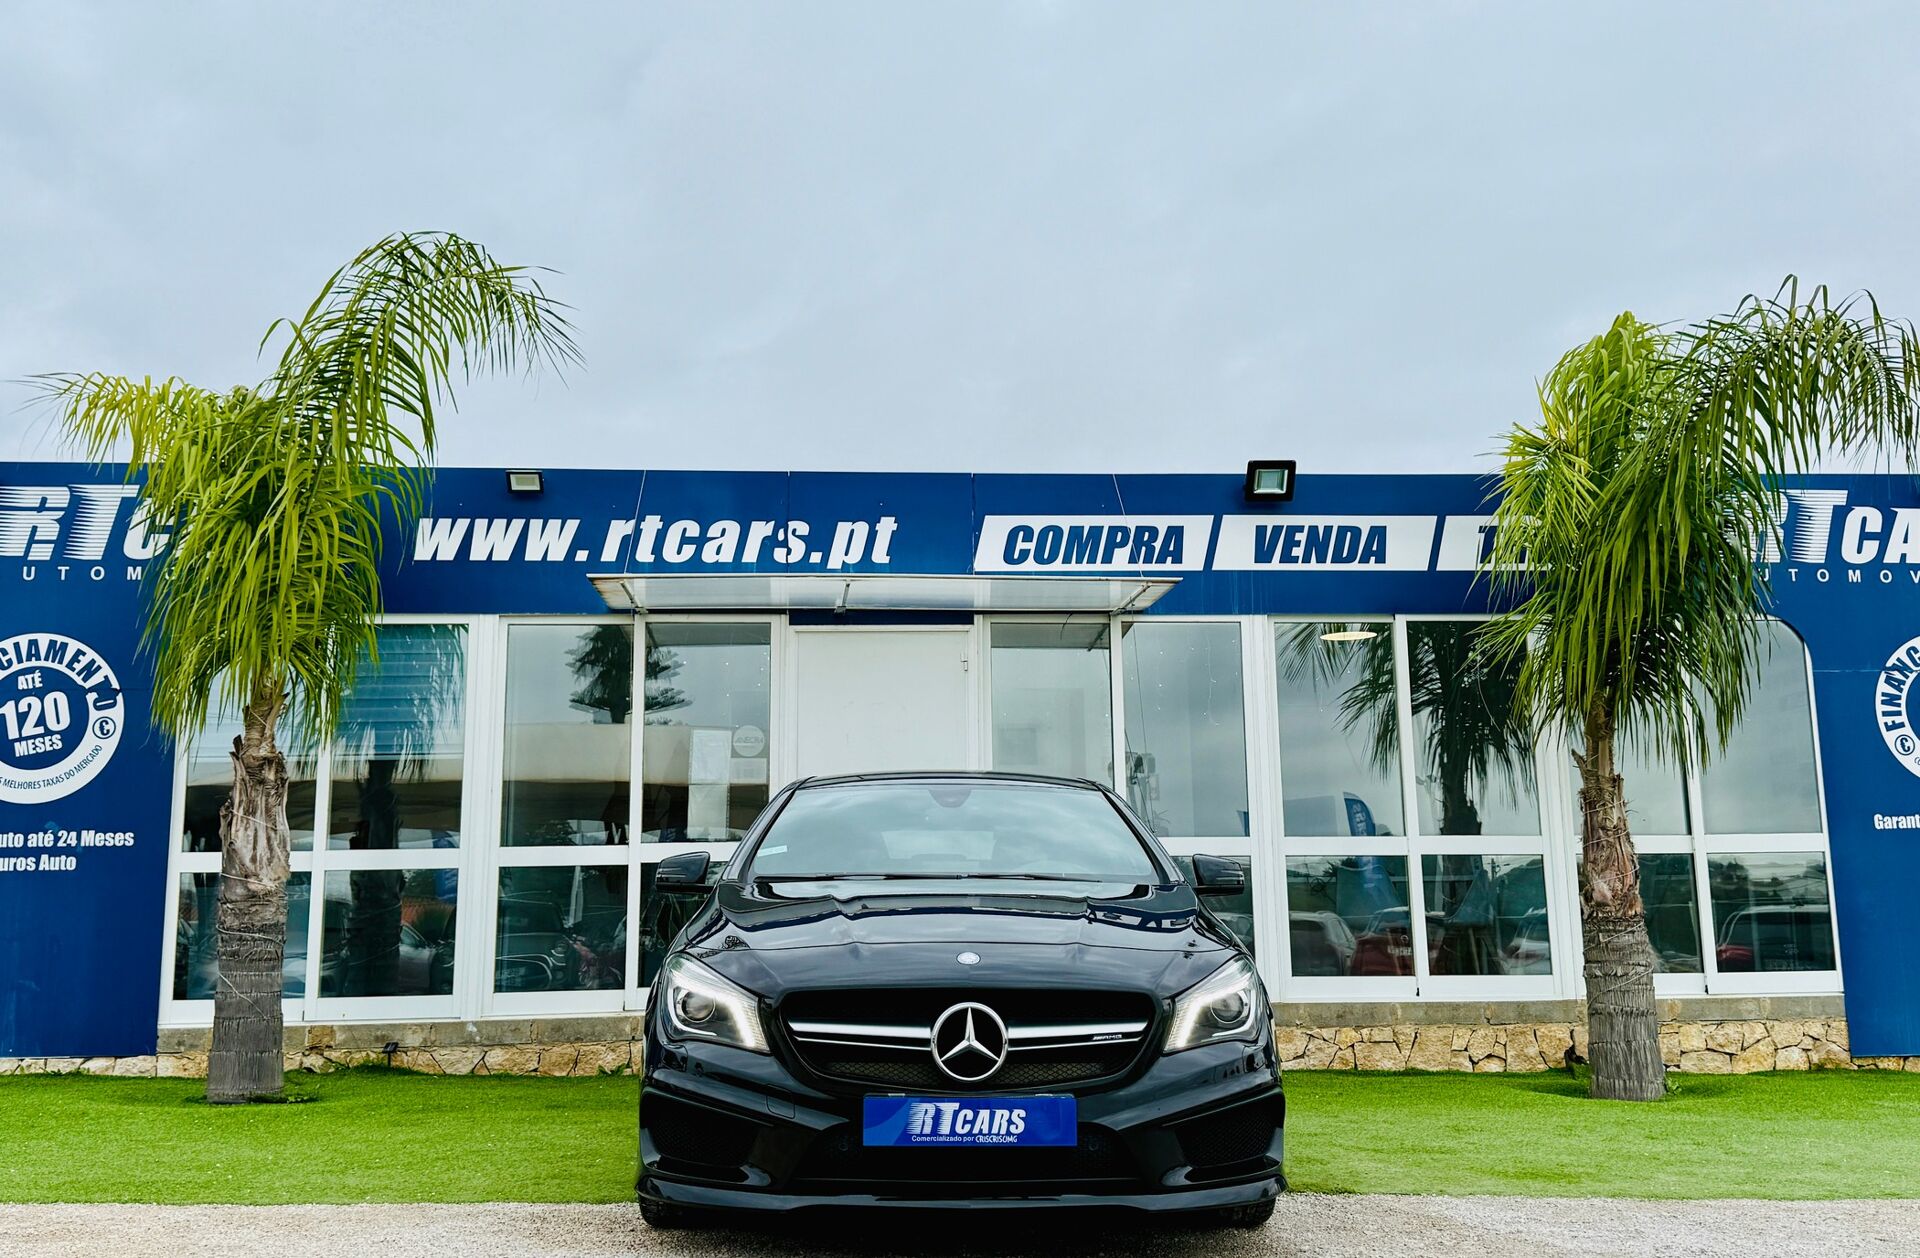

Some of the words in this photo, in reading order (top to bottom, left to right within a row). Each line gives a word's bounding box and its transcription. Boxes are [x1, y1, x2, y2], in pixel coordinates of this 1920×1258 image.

[413, 515, 898, 570] www.rtcars.pt
[1002, 525, 1184, 565] COMPRA
[1254, 525, 1387, 564] VENDA
[17, 670, 43, 690] ATÉ
[0, 691, 71, 740] 120
[14, 733, 63, 758] MESES
[2, 777, 41, 790] MELHORES
[42, 773, 65, 787] TAXAS
[65, 768, 76, 779] DO
[75, 744, 103, 775] MERCADO
[27, 830, 54, 848] até
[57, 830, 77, 847] 24
[80, 829, 135, 847] Meses
[38, 854, 77, 871] Auto
[906, 1102, 1026, 1135] RTCARS
[911, 1134, 962, 1142] Comercializado
